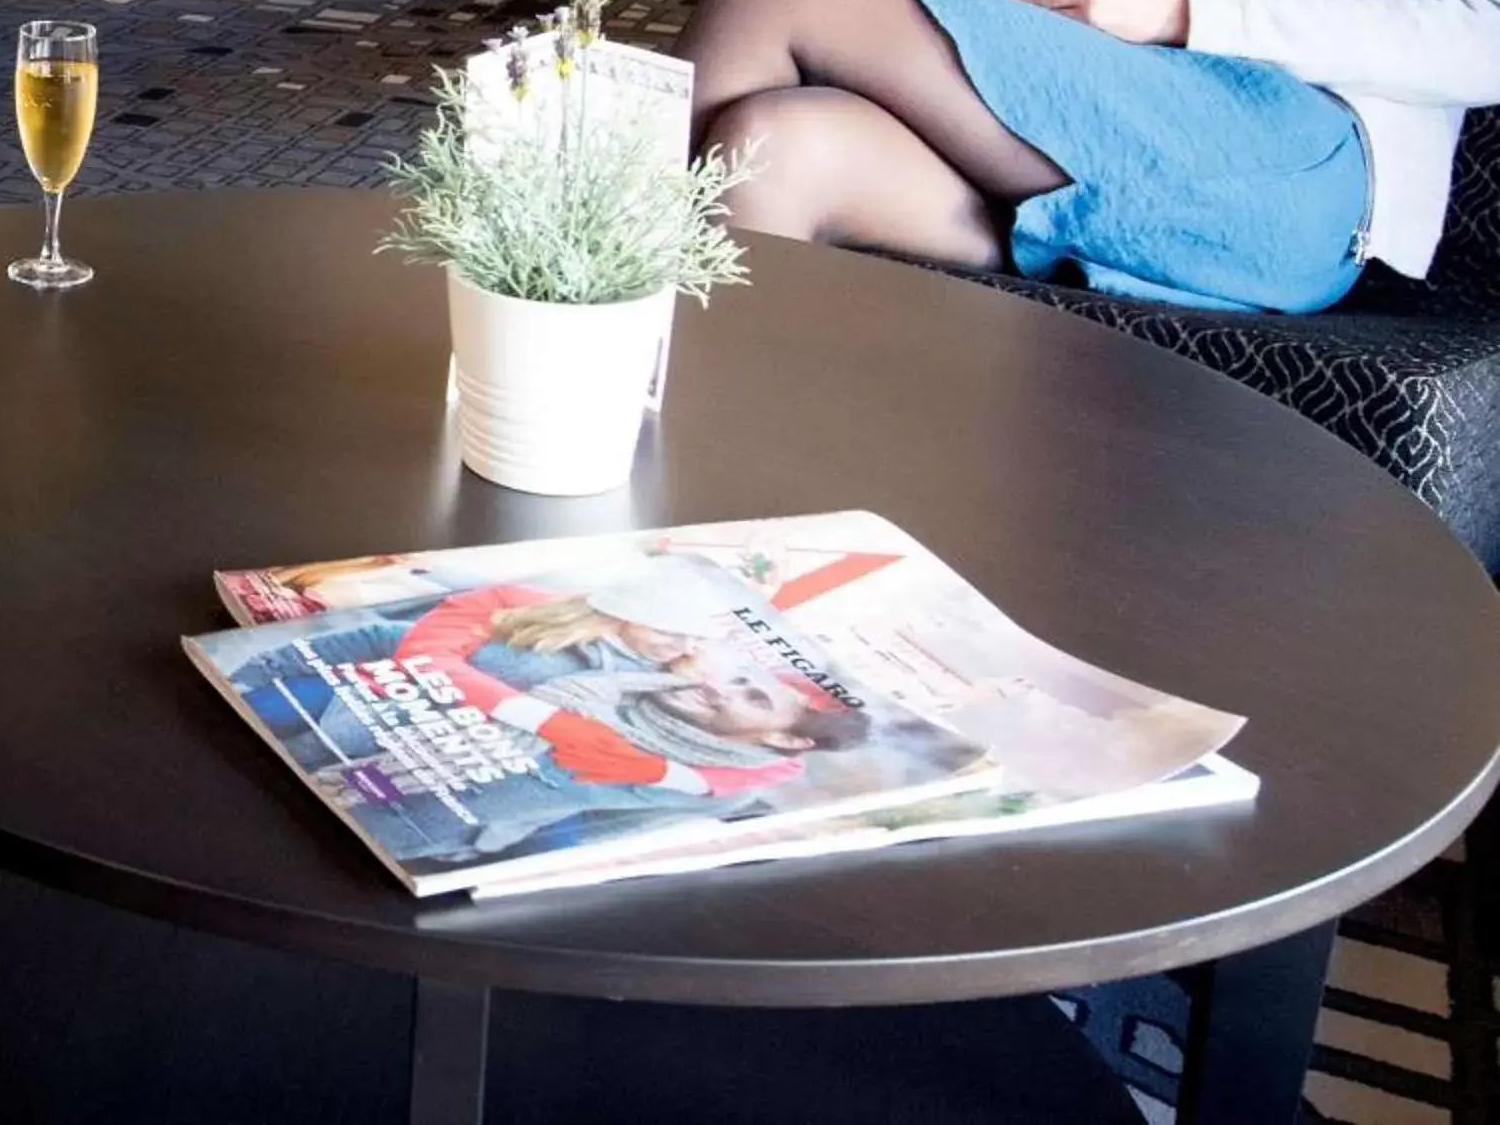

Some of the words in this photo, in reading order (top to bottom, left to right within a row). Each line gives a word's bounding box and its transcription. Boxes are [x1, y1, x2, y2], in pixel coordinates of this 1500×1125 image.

[401, 656, 466, 704] LES
[446, 706, 540, 775] BONS
[732, 607, 772, 633] LE
[764, 636, 866, 708] FIGARO
[360, 659, 506, 783] MOMENTS
